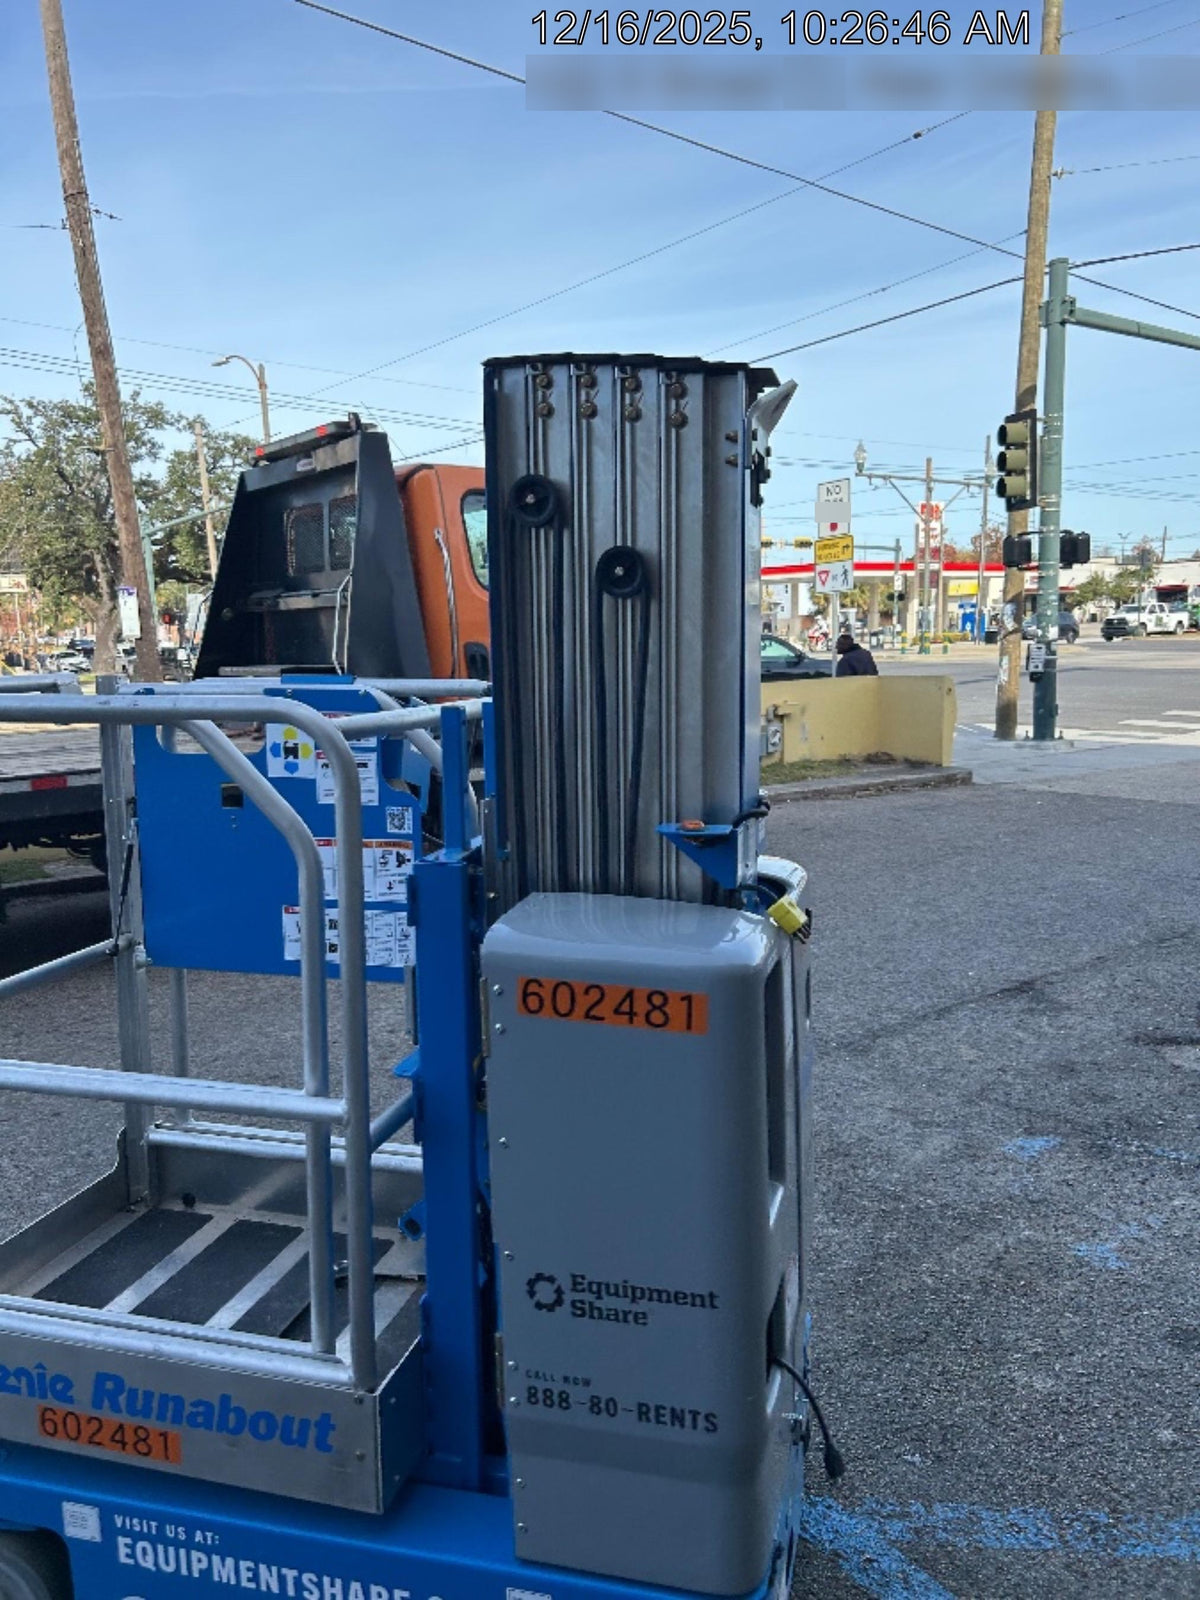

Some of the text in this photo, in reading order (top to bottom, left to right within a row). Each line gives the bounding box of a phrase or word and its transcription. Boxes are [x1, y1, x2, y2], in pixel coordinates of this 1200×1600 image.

[825, 485, 842, 497] NO
[521, 978, 695, 1031] 602481
[570, 1273, 720, 1310] Equipment
[570, 1299, 649, 1326] Share
[525, 1369, 592, 1388] CALL NOW
[0, 1362, 336, 1453] enie Runabout
[526, 1385, 719, 1433] 888-80-RENTS
[40, 1407, 170, 1460] 602481
[114, 1514, 220, 1545] VISIT US AT:
